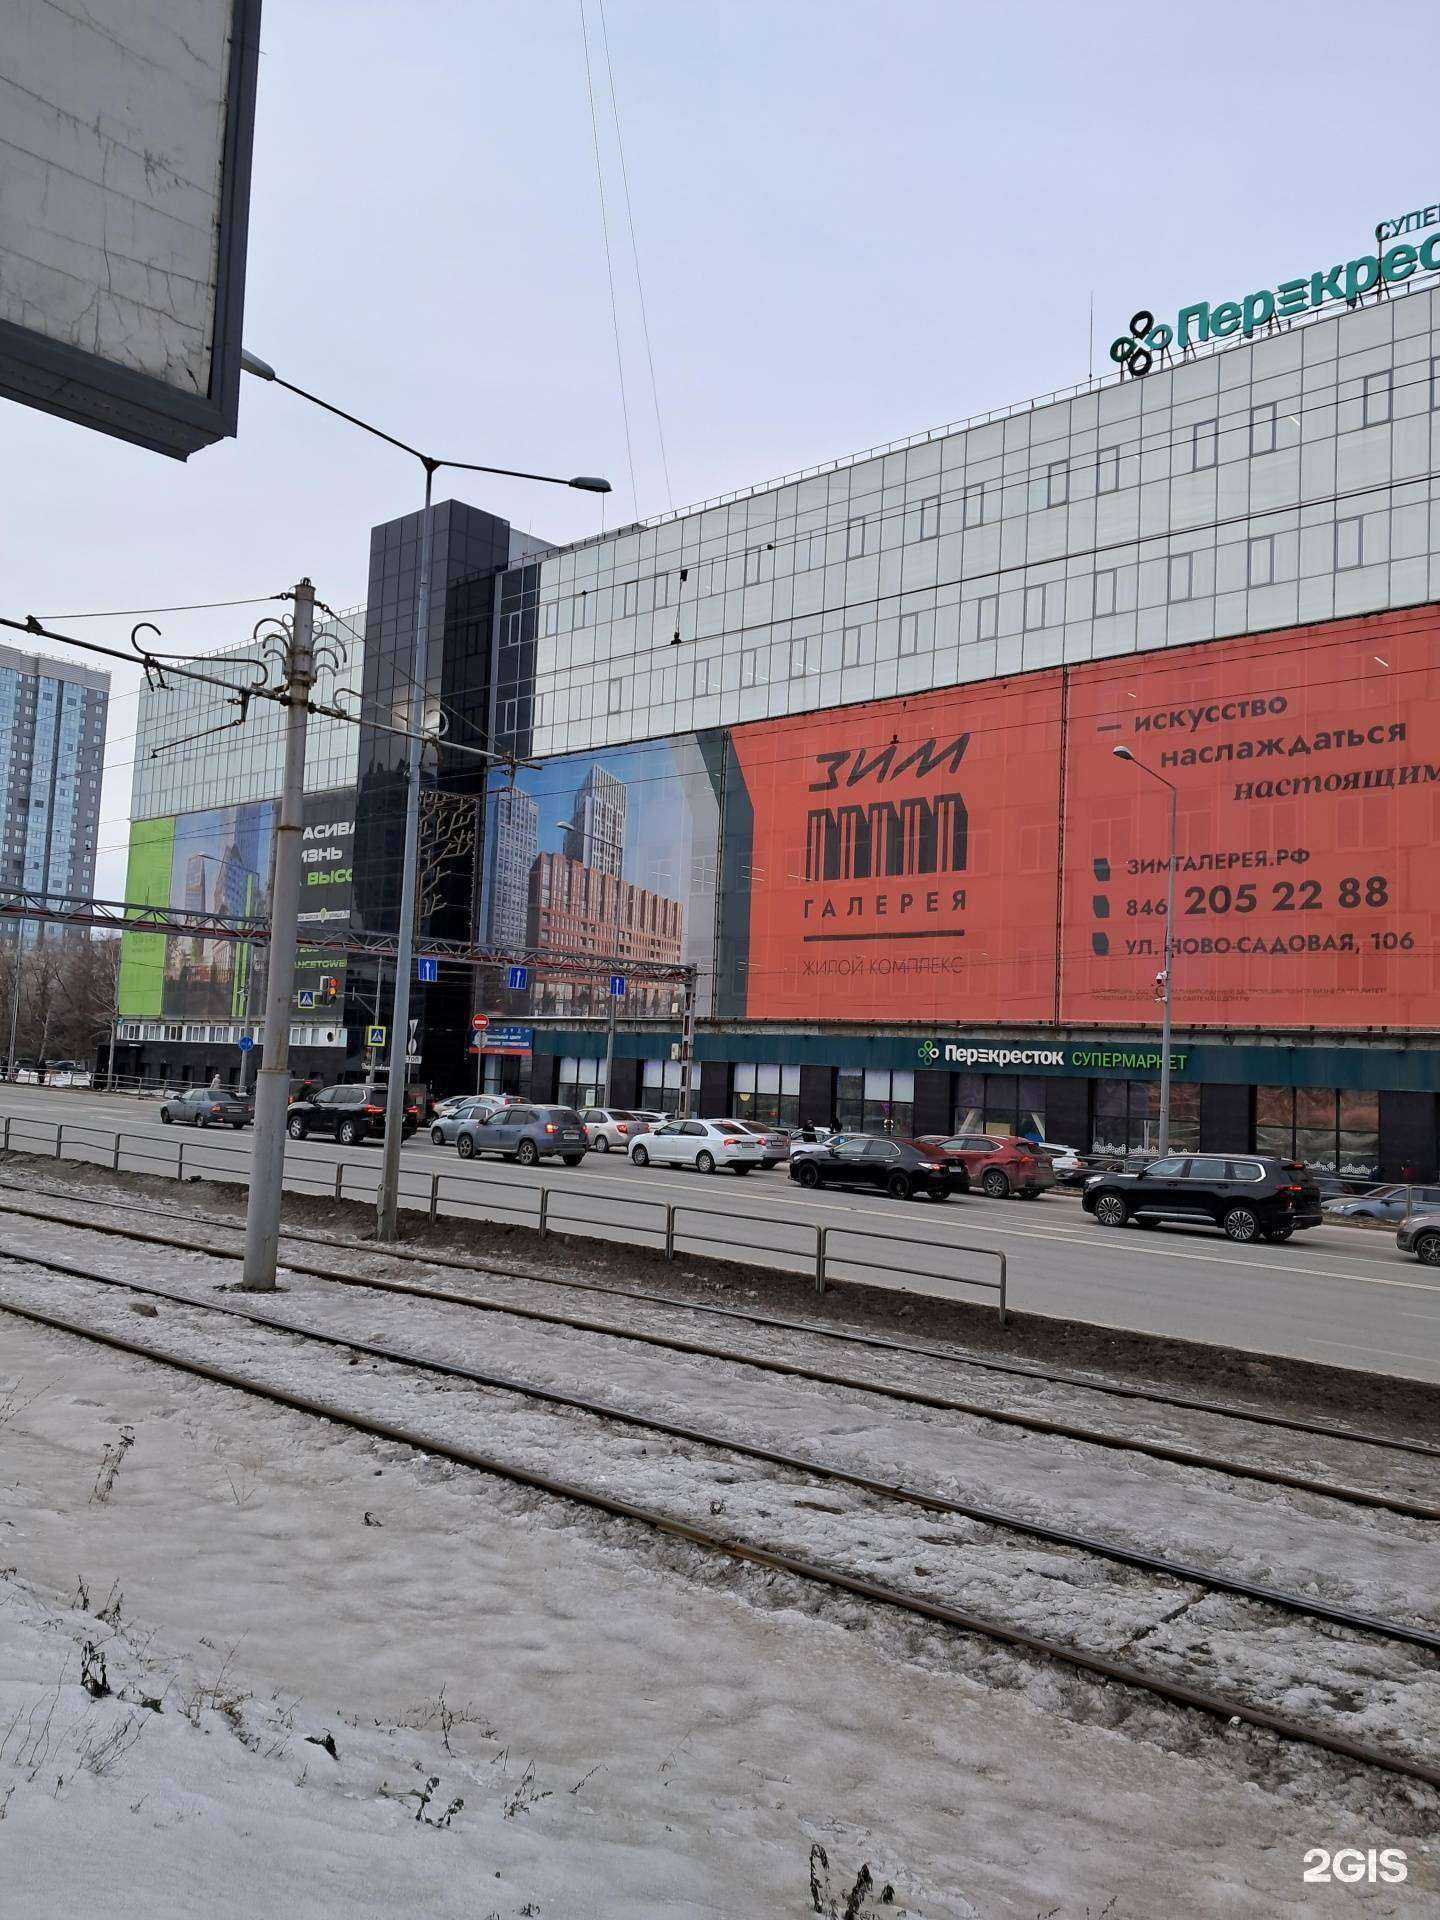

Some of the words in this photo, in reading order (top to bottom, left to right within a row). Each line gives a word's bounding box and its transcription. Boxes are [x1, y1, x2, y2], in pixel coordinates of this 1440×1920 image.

[1375, 203, 1440, 242] СУПЕ
[1134, 696, 1288, 733] искусство
[808, 732, 970, 793] ЗИМ
[1161, 722, 1407, 768] наслаждаться
[803, 890, 967, 918] ГАЛЕРЕЯ
[1126, 899, 1168, 917] 846
[1184, 883, 1258, 915] 205
[1272, 880, 1323, 912] 22
[1338, 876, 1389, 908] 88
[1126, 939, 1159, 956] УЛ.
[1371, 931, 1415, 952] 106
[802, 957, 864, 976] ЖИЛОЙ
[869, 956, 964, 976] КОМПЛЕКС
[945, 1044, 1065, 1068] Перекресток
